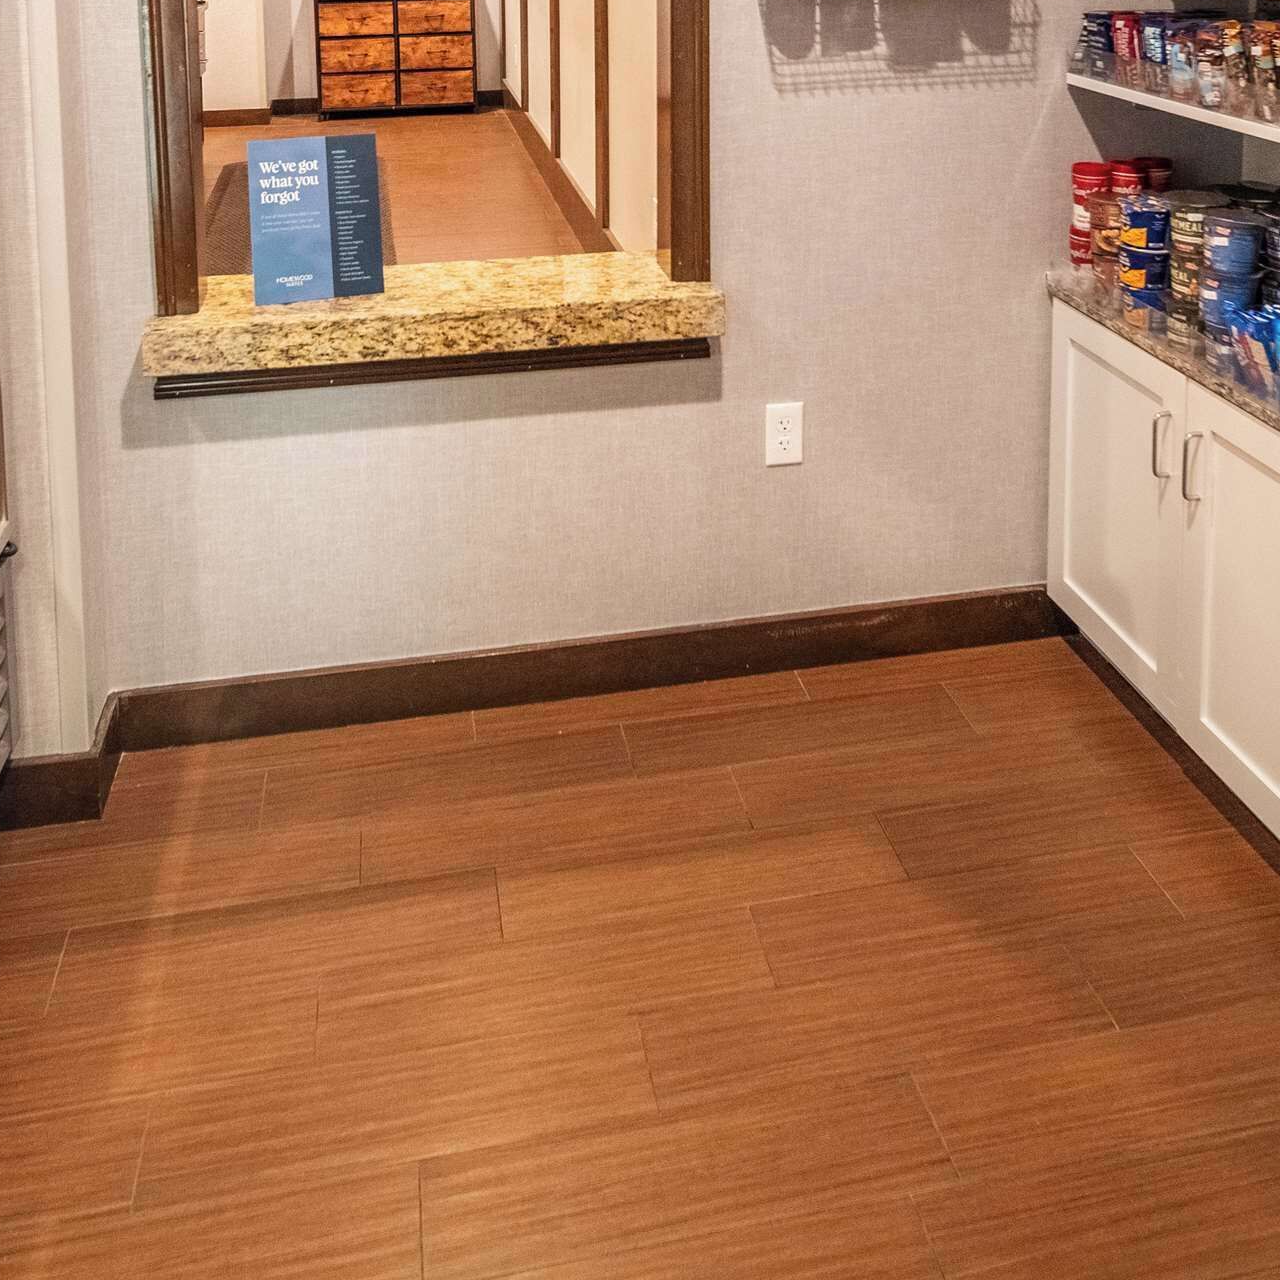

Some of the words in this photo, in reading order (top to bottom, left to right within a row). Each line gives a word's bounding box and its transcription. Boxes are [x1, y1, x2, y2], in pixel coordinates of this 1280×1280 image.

[259, 160, 297, 174] We've
[298, 159, 319, 173] got
[259, 175, 293, 189] what
[295, 174, 319, 189] you
[260, 190, 301, 205] forgot
